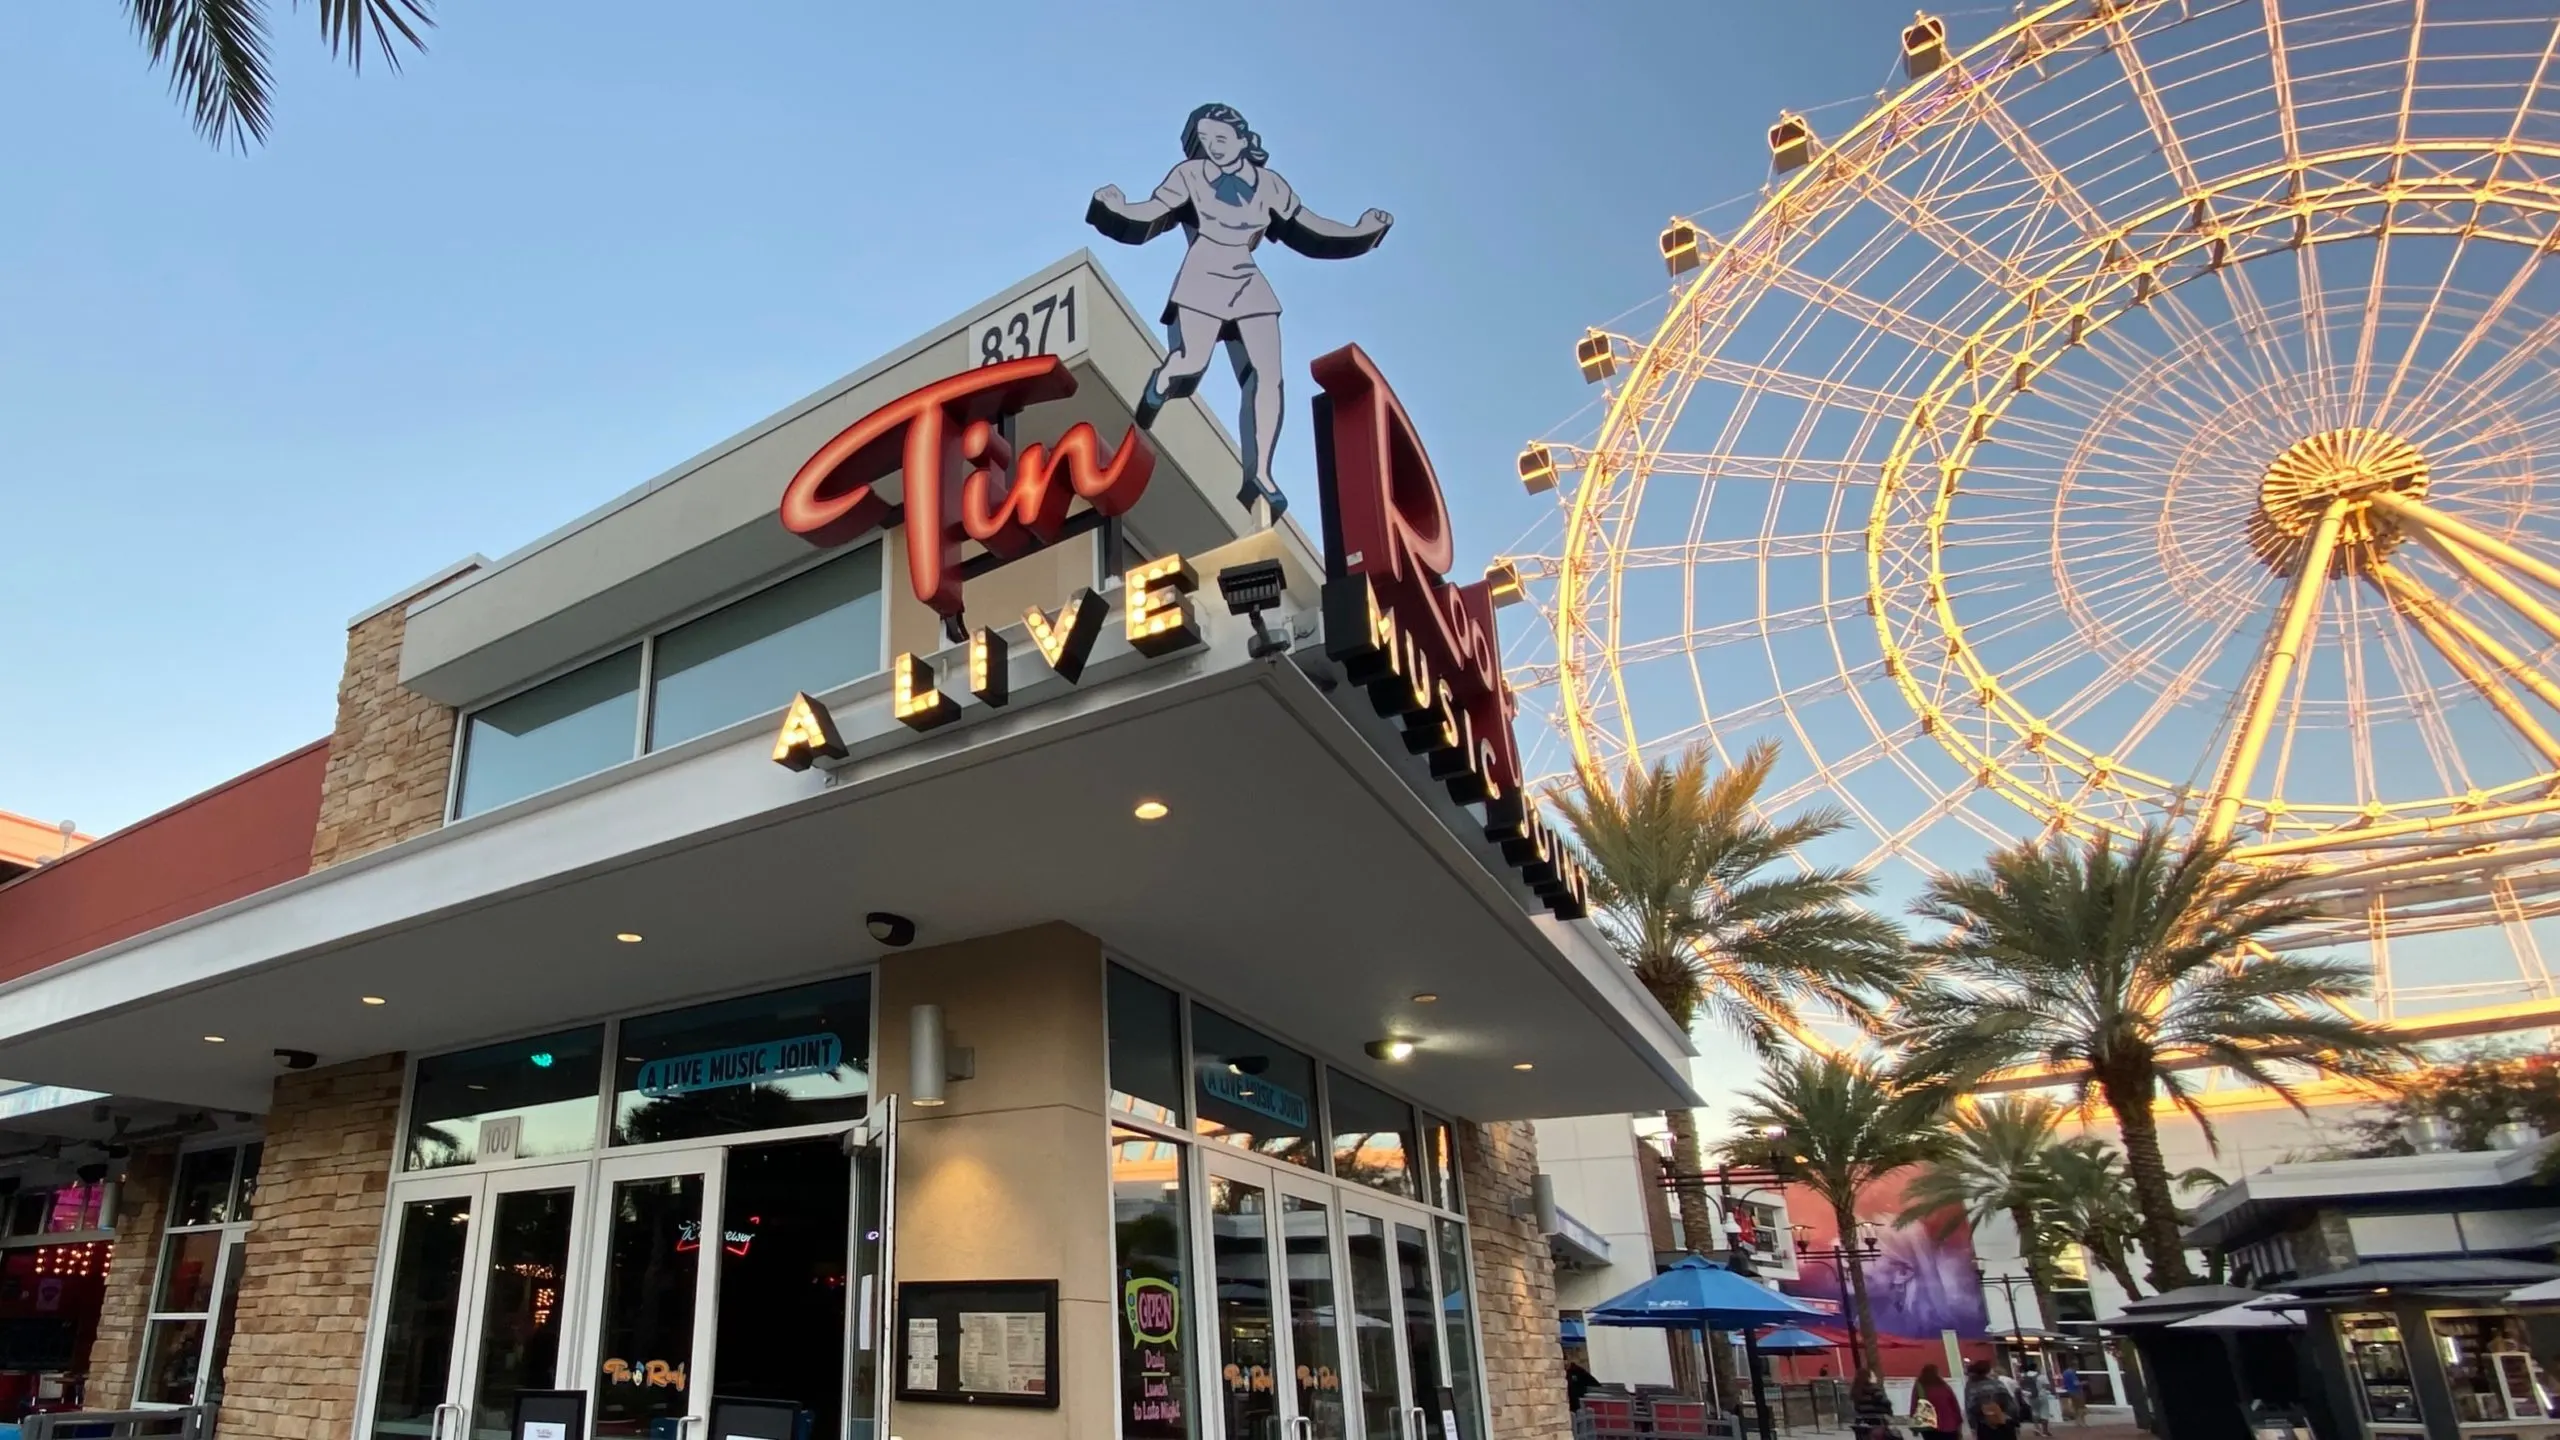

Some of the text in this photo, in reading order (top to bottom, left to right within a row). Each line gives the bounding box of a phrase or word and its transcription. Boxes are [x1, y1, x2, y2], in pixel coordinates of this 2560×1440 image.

[981, 285, 1076, 367] 8371
[780, 354, 1152, 612] Tin
[772, 553, 1200, 770] A LIVE
[1362, 571, 1501, 801] MUSIC
[645, 1038, 834, 1090] A LIVE MUSIC JOINT
[485, 1126, 512, 1155] 100
[1139, 1292, 1173, 1331] OPEN
[1144, 1349, 1167, 1372] Daily
[1143, 1377, 1169, 1398] Lunch
[1133, 1400, 1181, 1424] to Late Night
